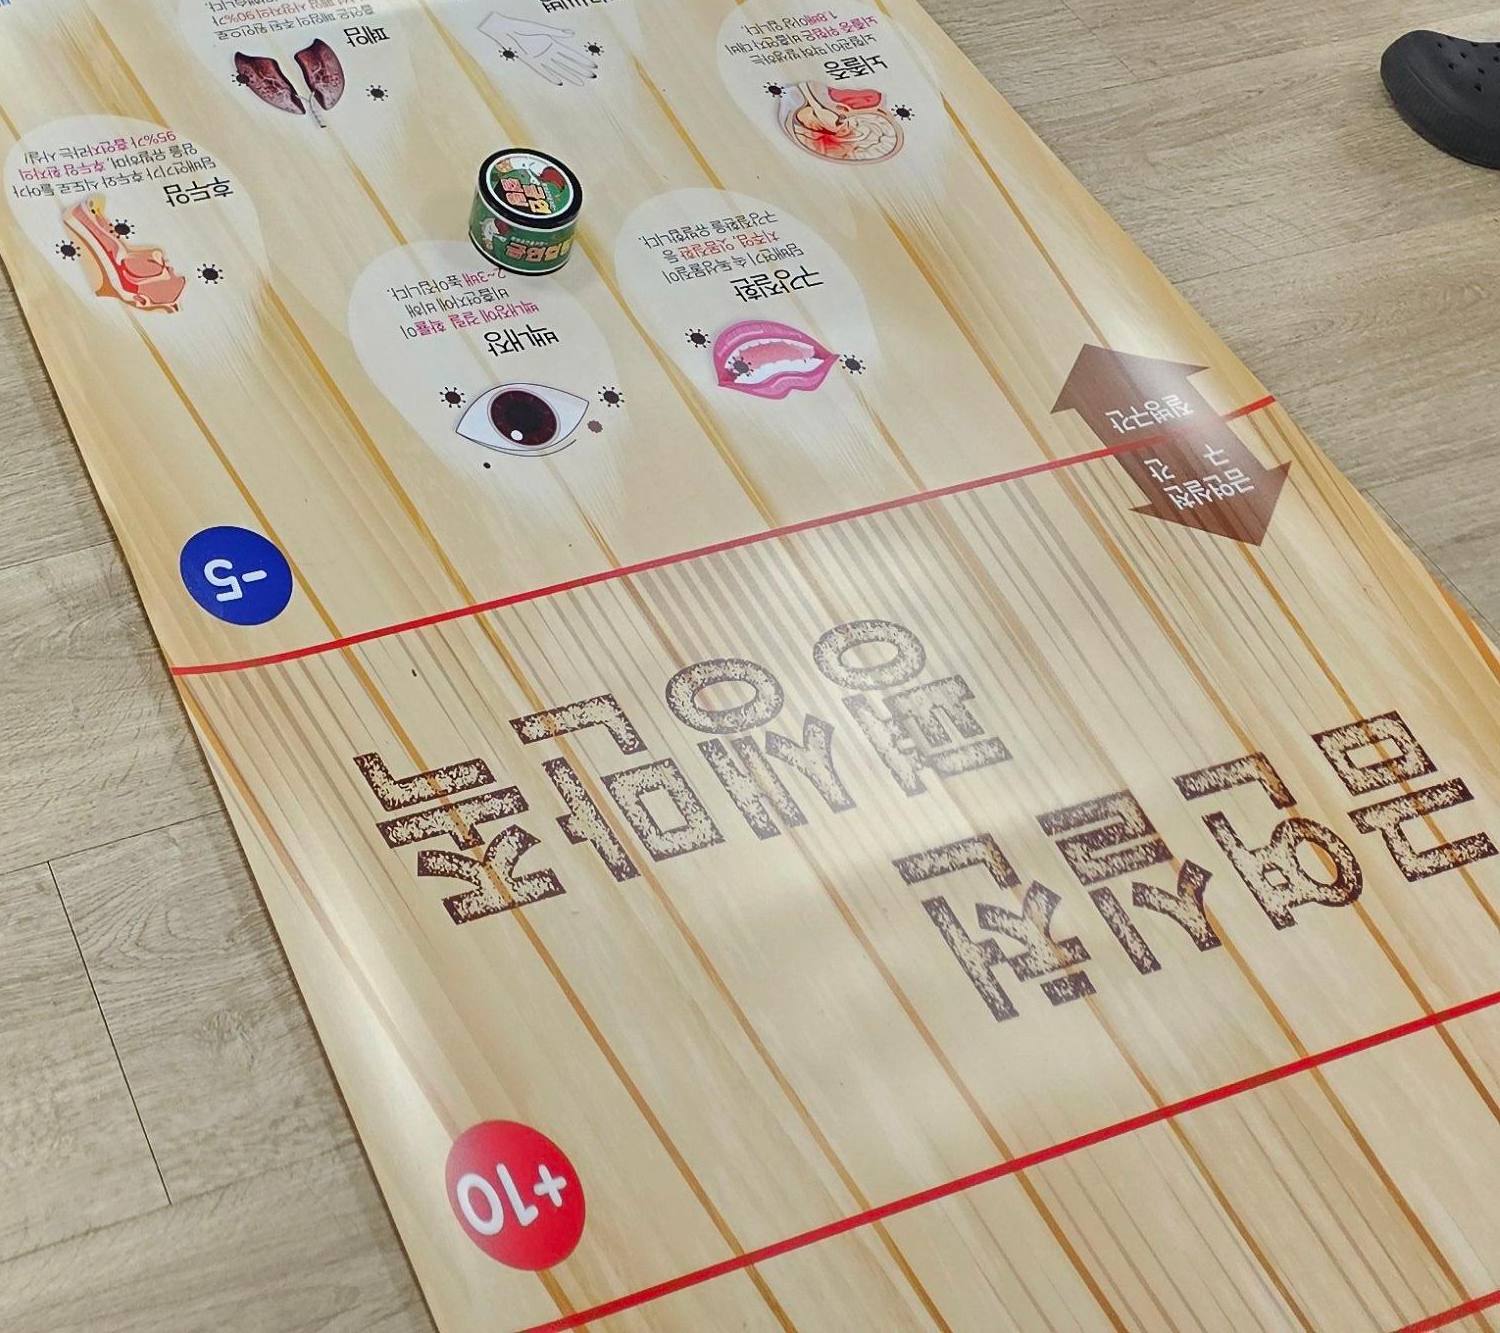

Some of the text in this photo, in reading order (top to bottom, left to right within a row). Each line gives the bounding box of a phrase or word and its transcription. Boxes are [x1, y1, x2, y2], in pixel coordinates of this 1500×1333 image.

[343, 25, 390, 48] 폐암
[59, 137, 129, 160] 흡연자라는
[129, 130, 176, 151] 95%가
[167, 142, 198, 157] 암을
[18, 167, 61, 182] 환자의
[63, 160, 106, 177] 후두암
[99, 169, 143, 188] 후두와
[145, 156, 216, 179] 담배연기가
[55, 177, 99, 195] 식도로
[162, 176, 234, 208] 후두암
[638, 210, 778, 249] 구강질환을 유발합니다.
[662, 230, 779, 263] 치주염, 잇몸질환 등
[661, 243, 804, 284] 담배연기 속 독성물질이
[386, 274, 462, 301] 높아집니다.
[730, 265, 824, 302] 구강질환
[404, 286, 510, 318] 비흡연자에 비해
[400, 300, 539, 339] 백내장에 걸릴 확률이
[483, 324, 559, 357] 백내장
[1104, 393, 1194, 434] 질병구간
[1163, 466, 1254, 510] 금연실천
[201, 555, 269, 603] -5
[351, 616, 1010, 928] 평생만족
[891, 709, 1499, 1024] 금연실천
[454, 1157, 569, 1237] +10
